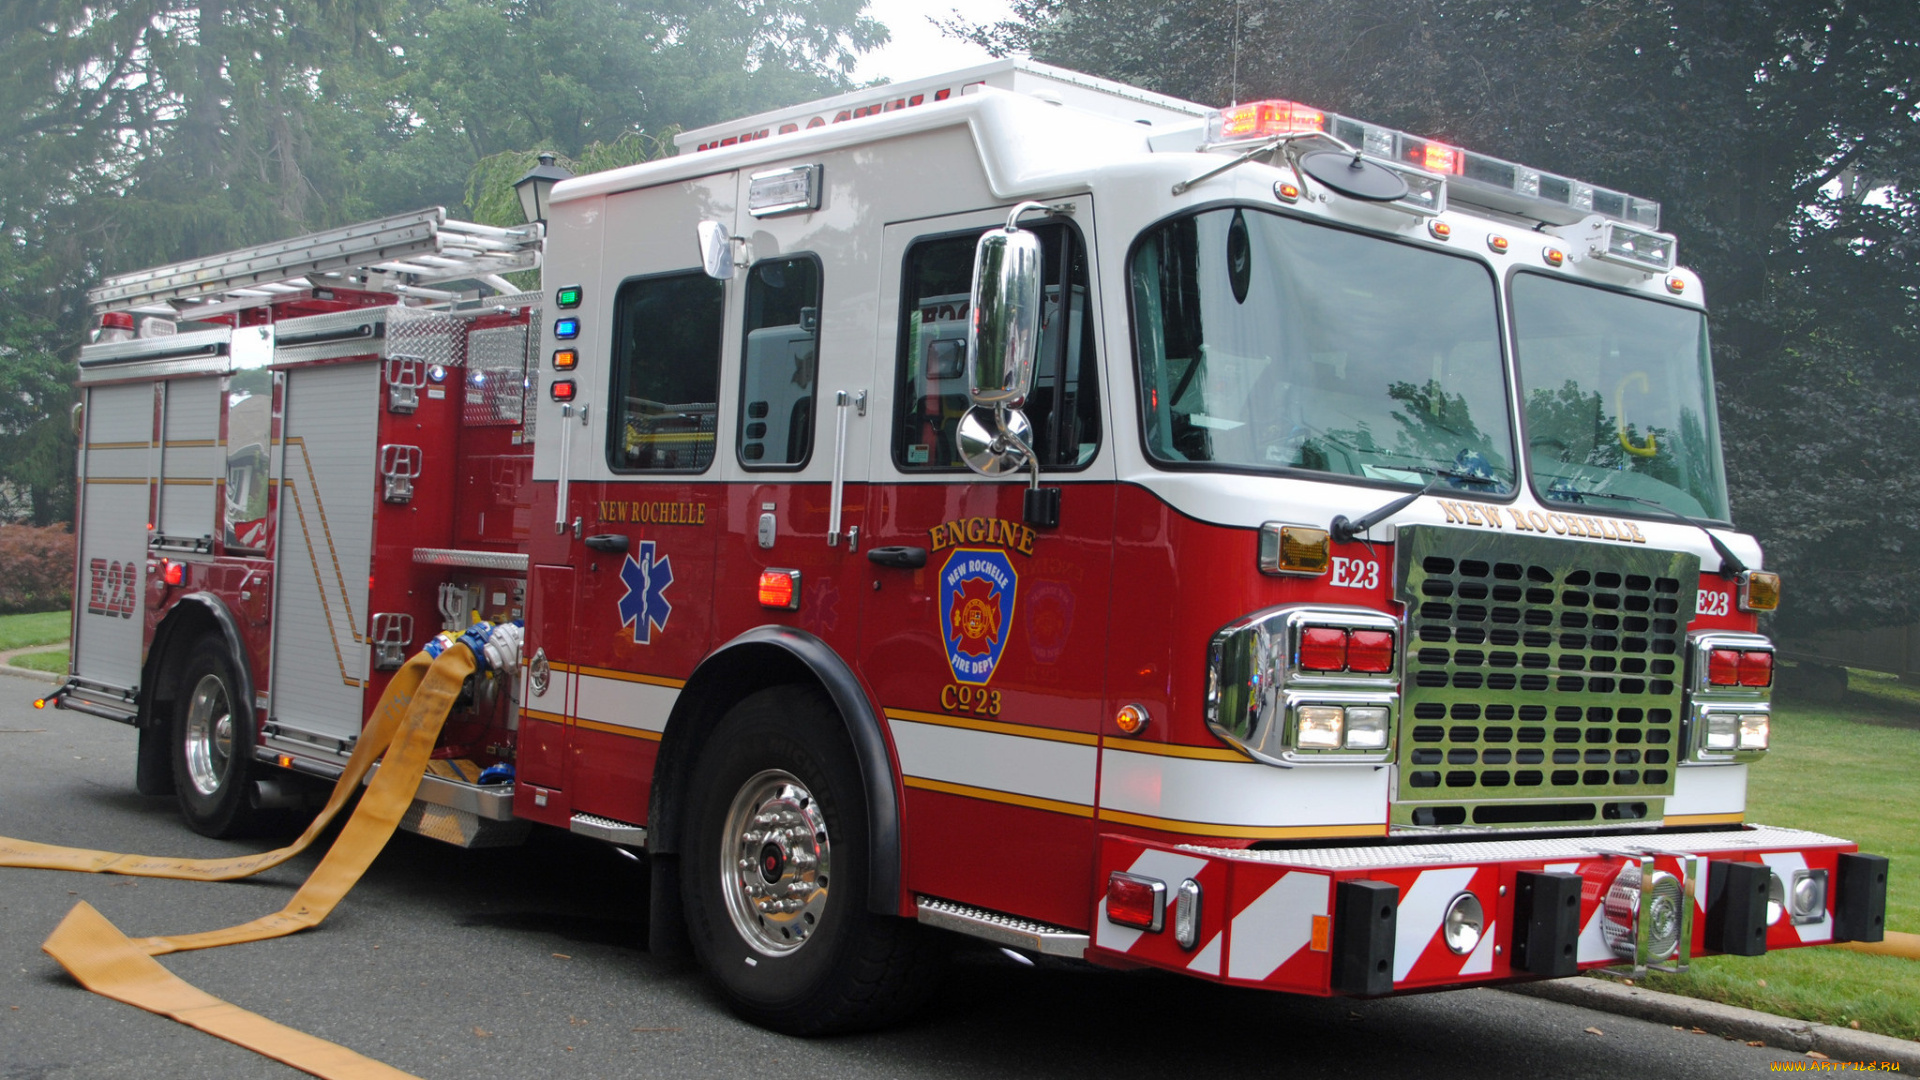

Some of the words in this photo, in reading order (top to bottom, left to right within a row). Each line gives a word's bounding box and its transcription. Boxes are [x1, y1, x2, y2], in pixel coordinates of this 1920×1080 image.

[599, 501, 629, 523] NEW
[630, 501, 706, 526] ROCHELLE
[1437, 500, 1503, 529] NEW
[1506, 506, 1647, 544] ROCHELLE
[929, 517, 1038, 557] ENGINE
[88, 557, 137, 620] E23
[947, 562, 967, 587] NEW
[968, 559, 1009, 590] ROCHELLE
[1329, 556, 1380, 590] E23
[1695, 589, 1730, 617] E23
[951, 653, 971, 674] FIRE
[971, 656, 994, 675] DEPT
[974, 688, 1002, 716] 23
